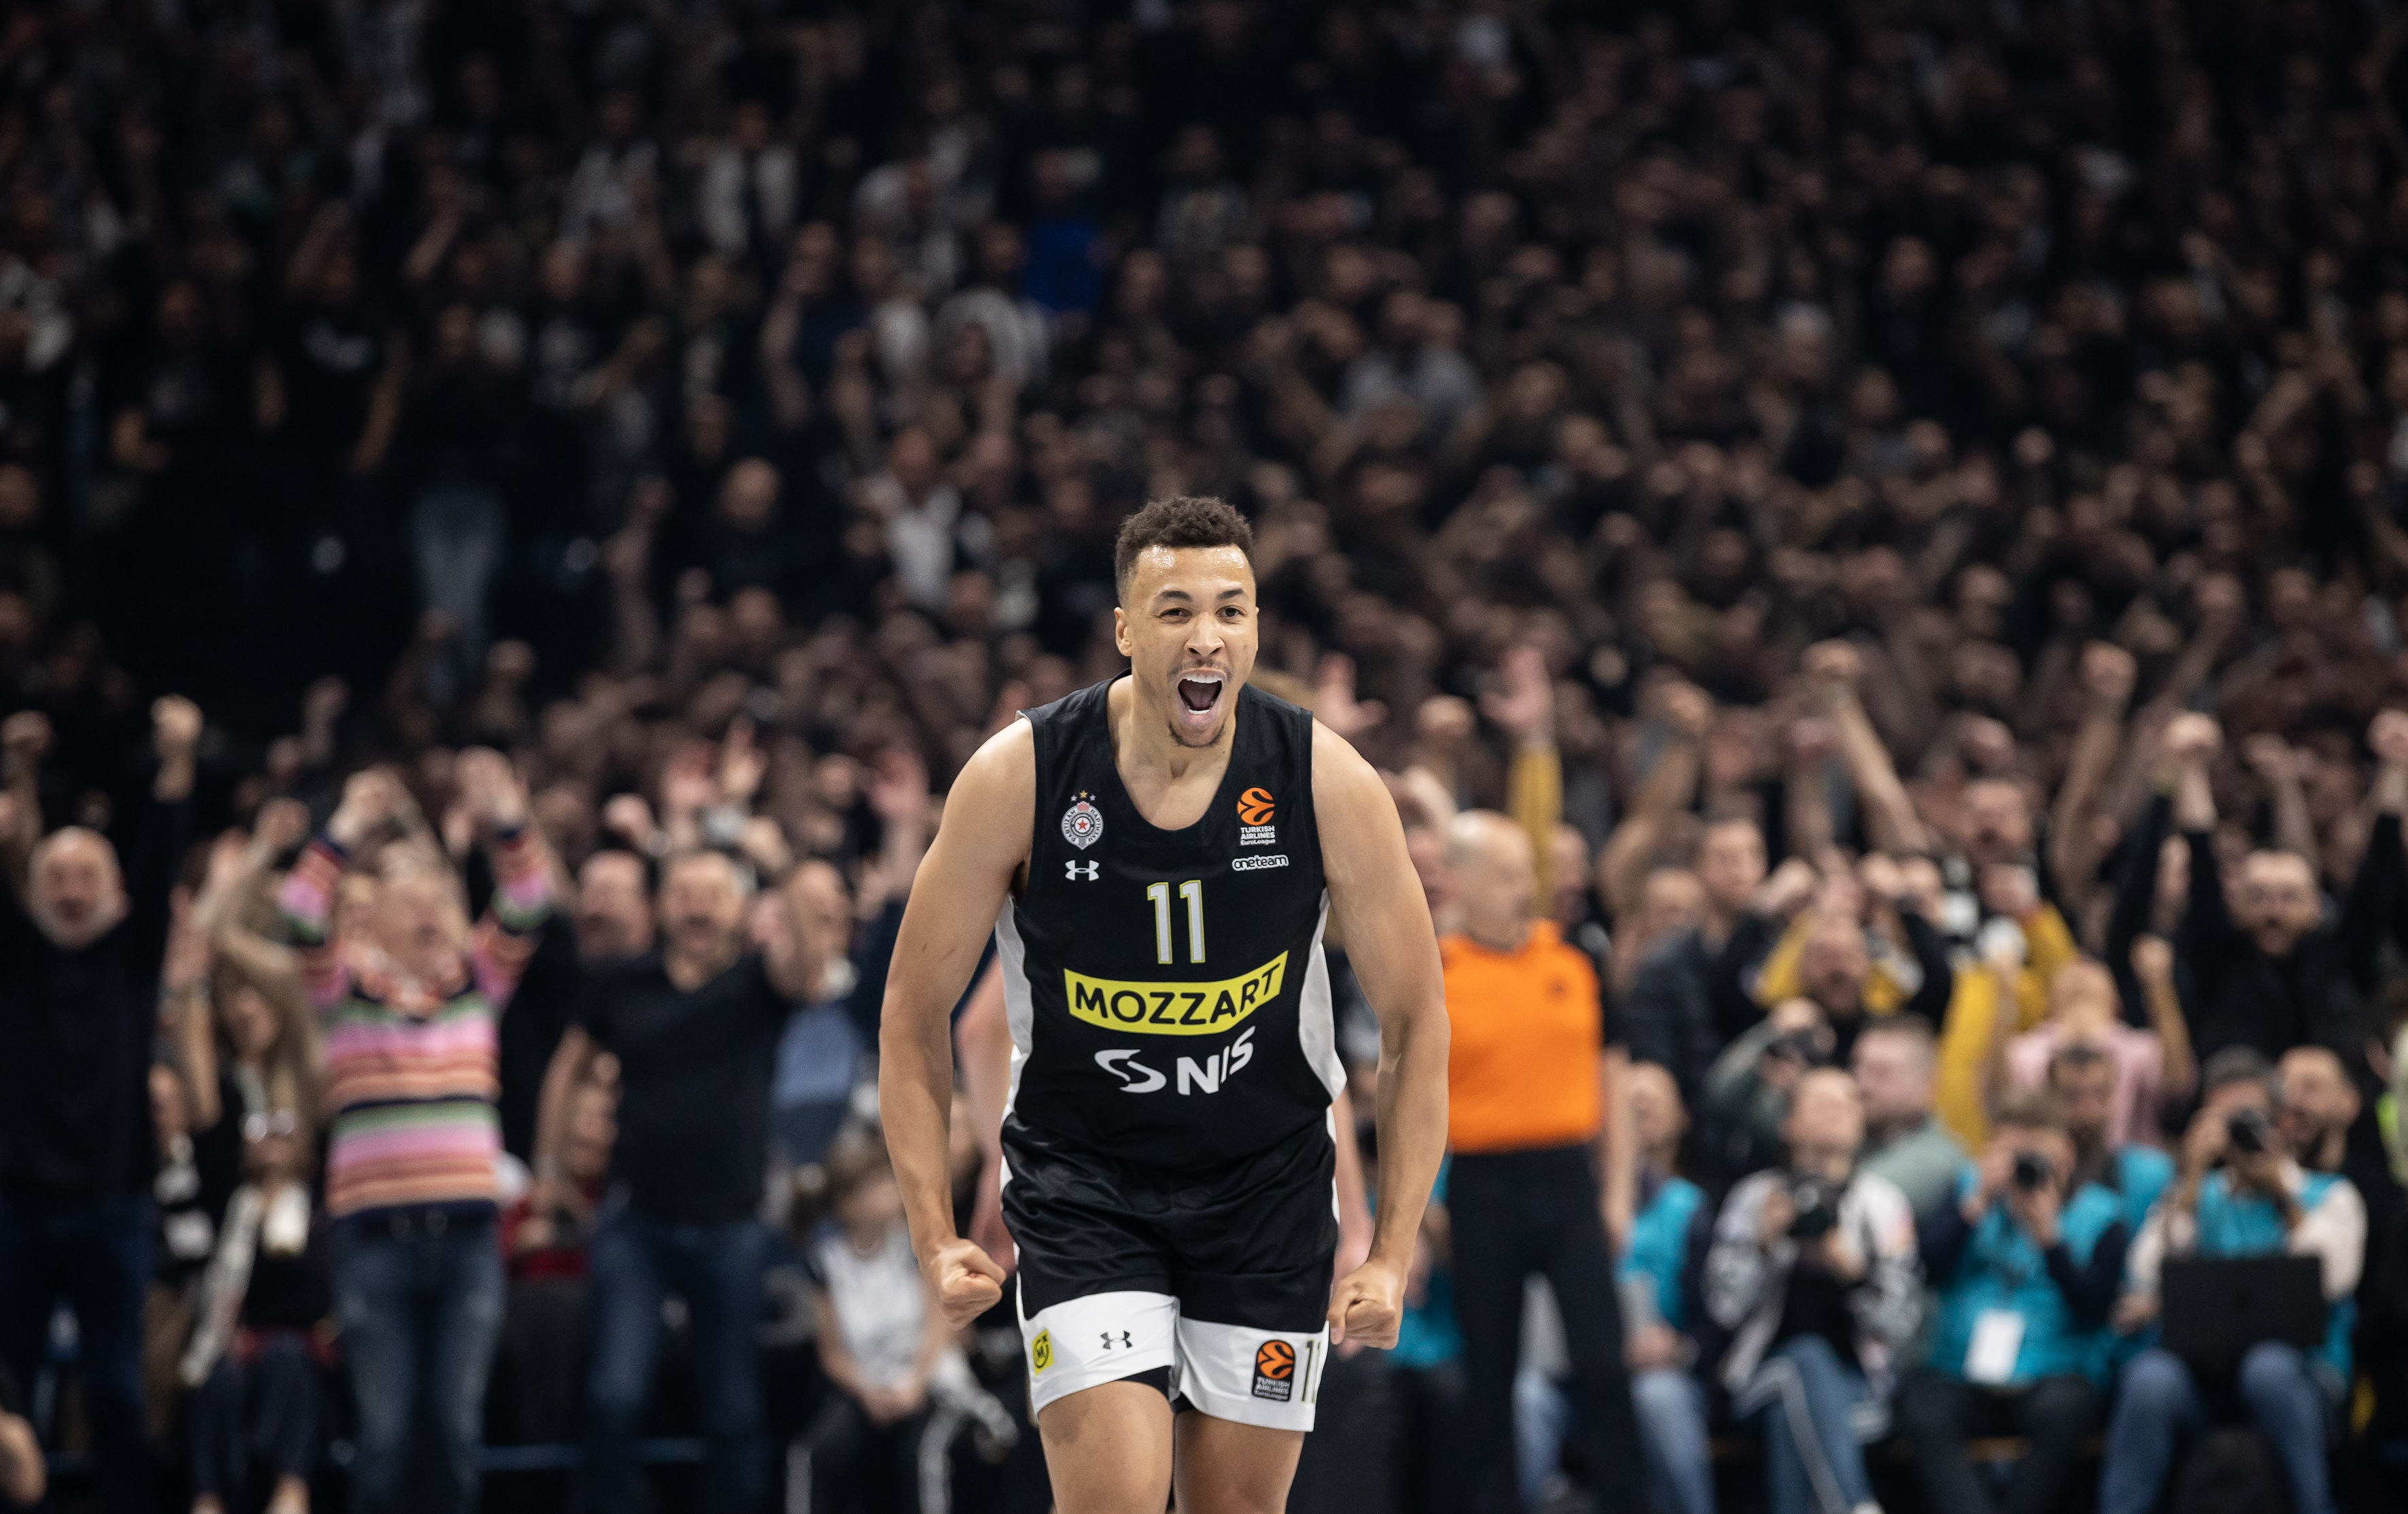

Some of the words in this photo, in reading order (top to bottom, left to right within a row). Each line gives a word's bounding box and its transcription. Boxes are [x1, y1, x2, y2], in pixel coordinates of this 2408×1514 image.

[1240, 825, 1275, 833] TURKISH
[1240, 831, 1275, 840] AIRLINES
[1233, 855, 1288, 870] oneteam
[1147, 880, 1205, 964] 11
[1076, 963, 1280, 1025] MOZZART
[1177, 1025, 1255, 1096] NIS
[1257, 1376, 1290, 1387] TURKISH
